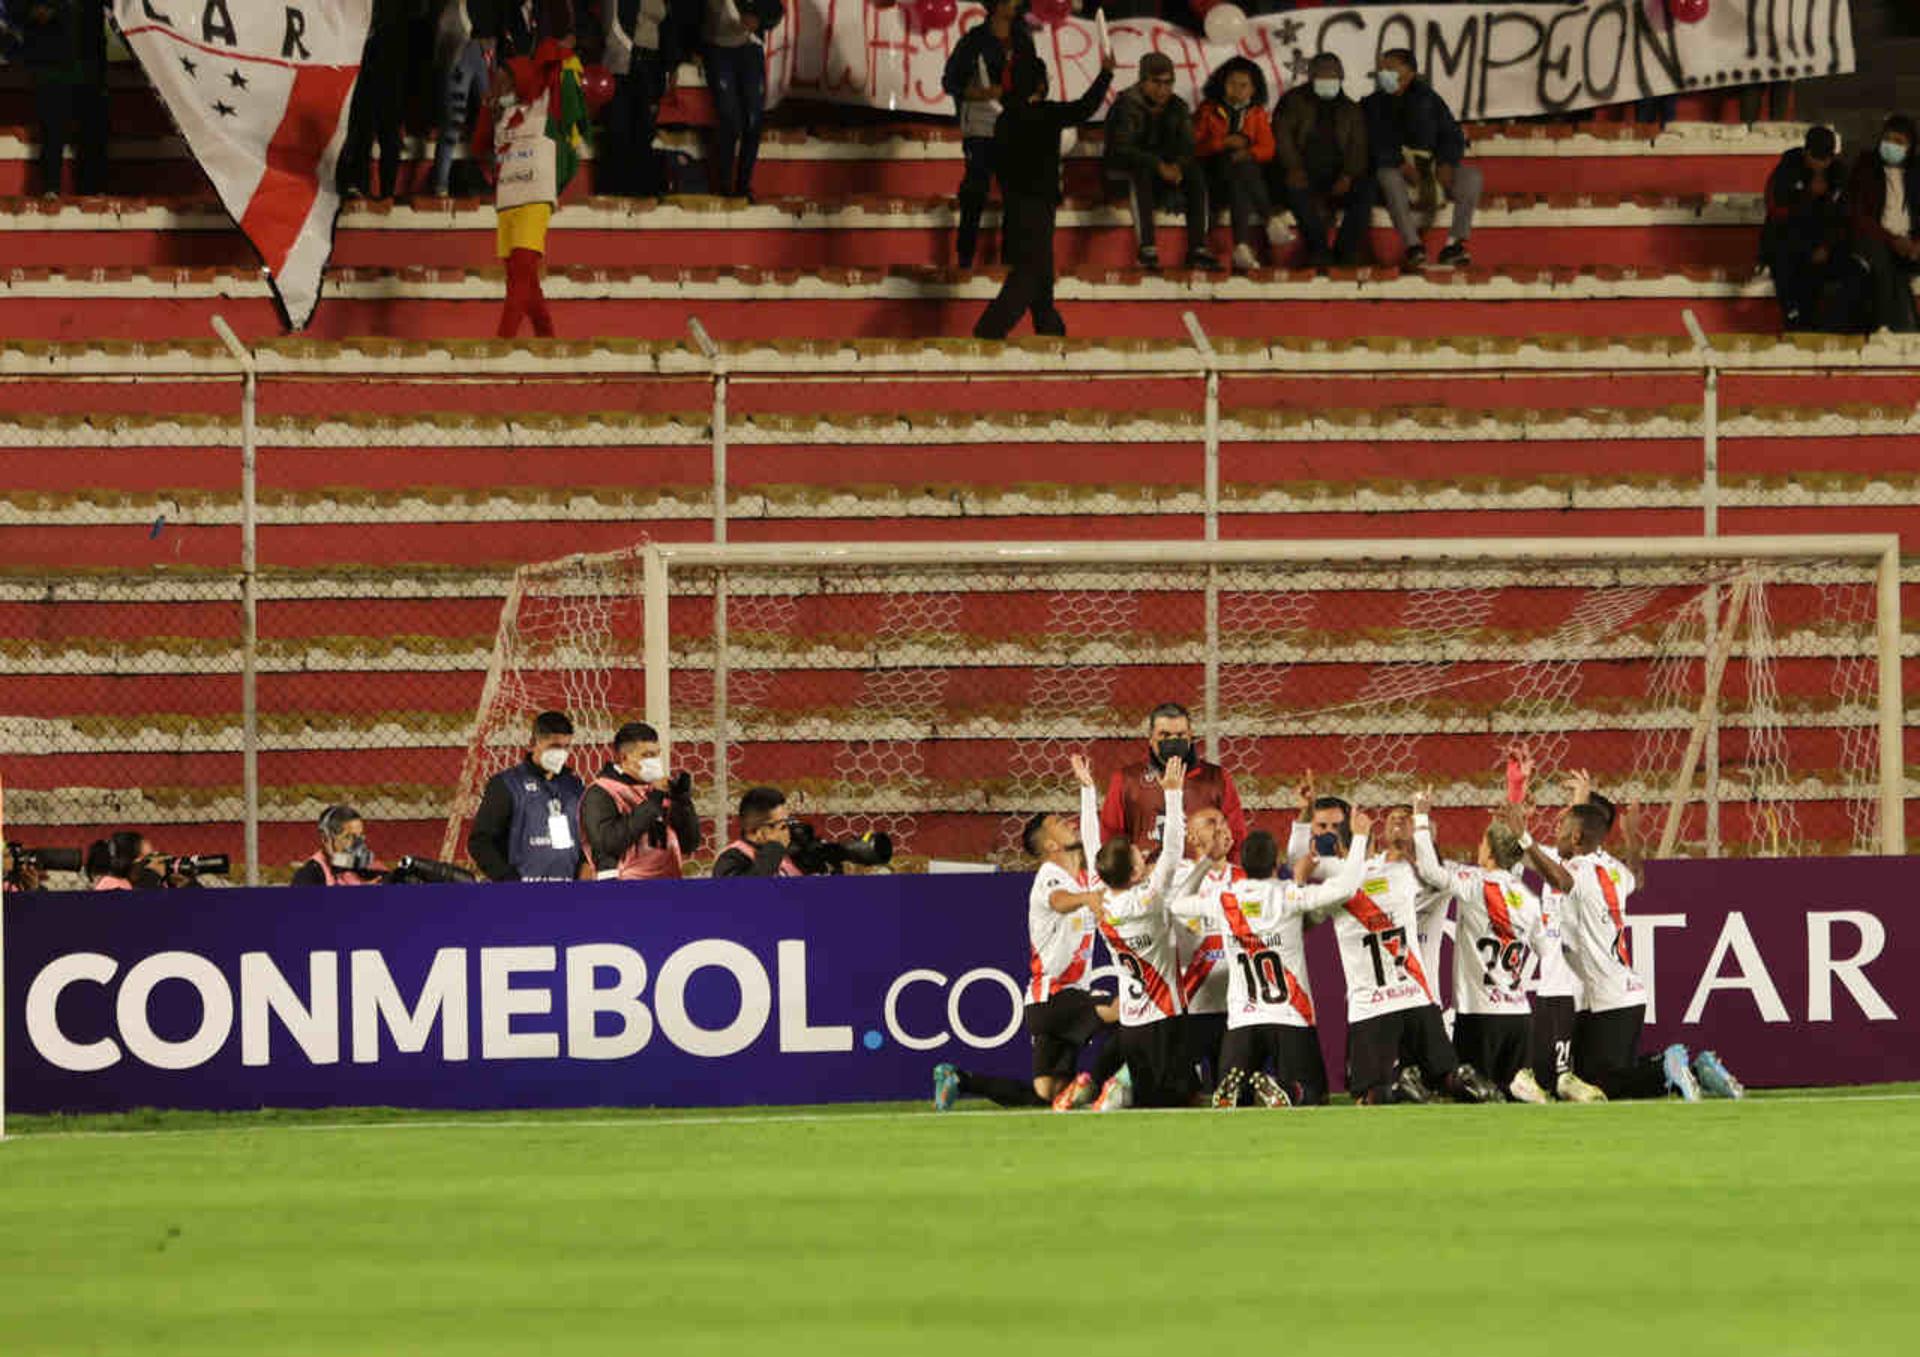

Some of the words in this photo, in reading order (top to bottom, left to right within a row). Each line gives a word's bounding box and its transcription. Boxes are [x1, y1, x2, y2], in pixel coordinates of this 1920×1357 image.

[1118, 953, 1145, 999] 3
[1238, 951, 1288, 1004] 10
[1362, 926, 1407, 987] 17
[1476, 937, 1524, 990] 29
